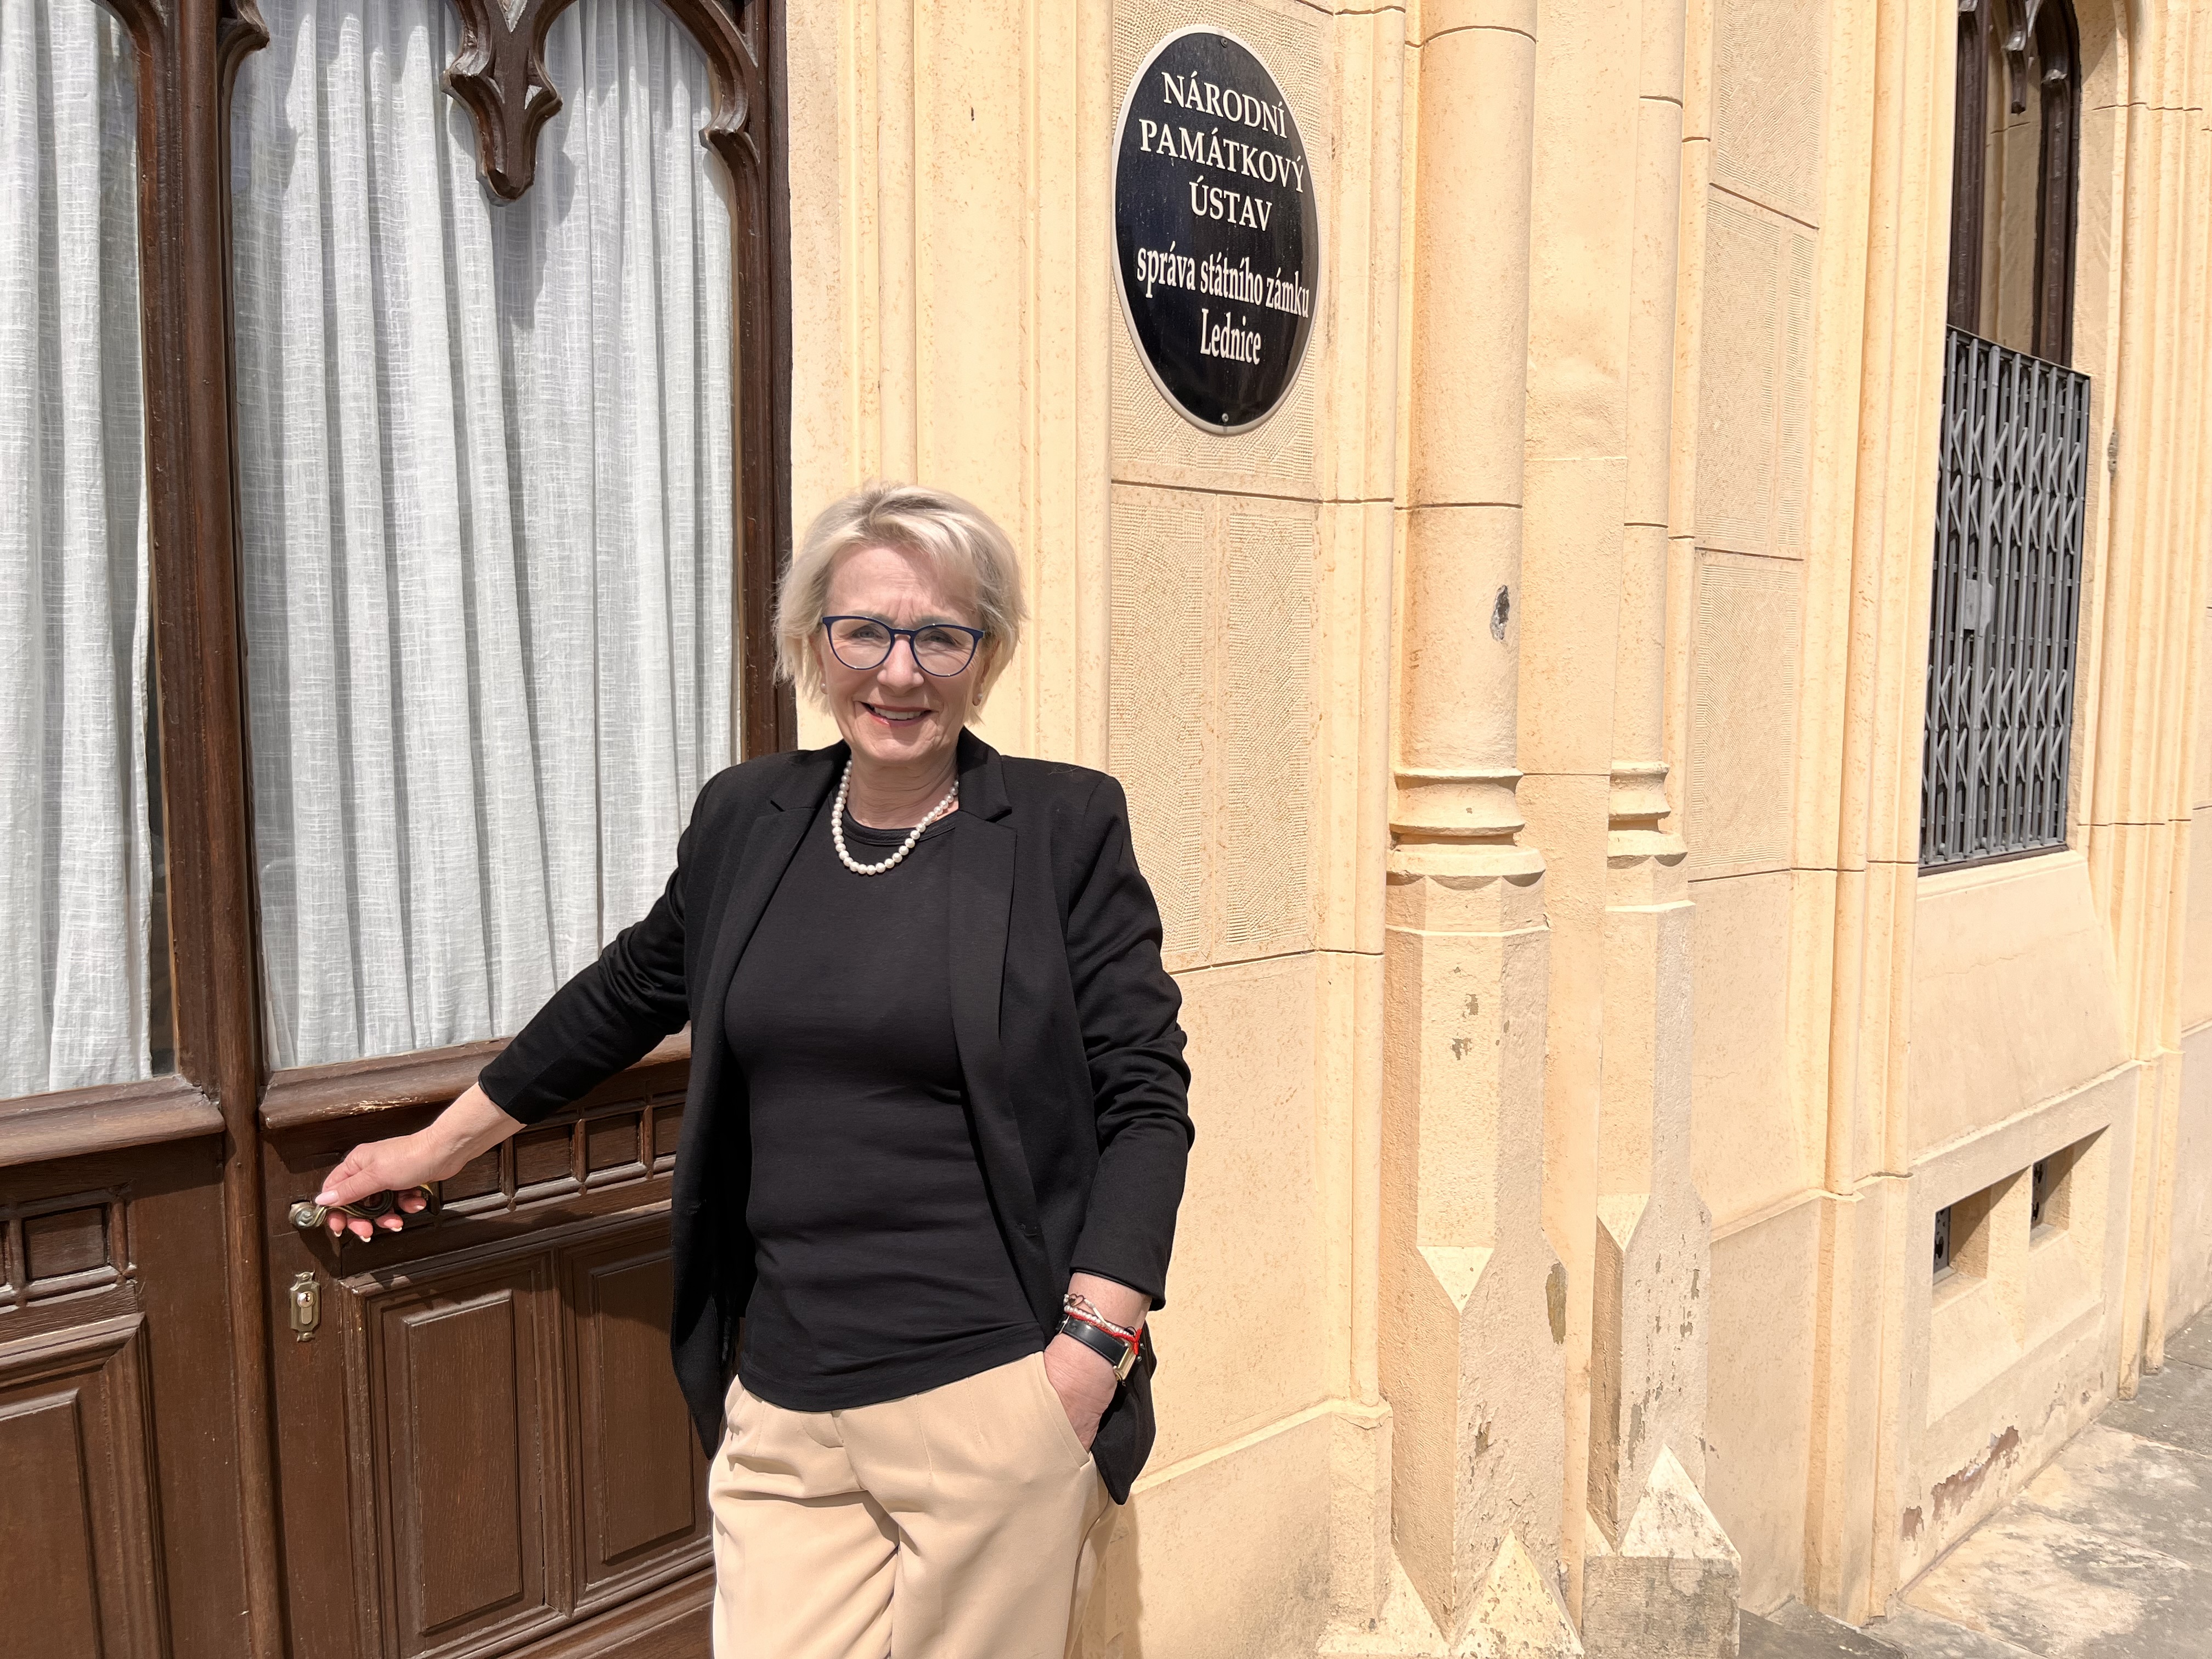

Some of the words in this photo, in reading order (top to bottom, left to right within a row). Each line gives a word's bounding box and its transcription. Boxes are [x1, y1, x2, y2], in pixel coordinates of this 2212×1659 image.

[1161, 71, 1287, 139] NÁRODNÍ
[1138, 119, 1303, 193] PAMÁTKOVÝ
[1189, 176, 1272, 231] ÚSTAV
[1137, 240, 1195, 298] správa
[1200, 252, 1262, 307] státního
[1266, 267, 1309, 318] zámku
[1200, 308, 1261, 365] Lednice
